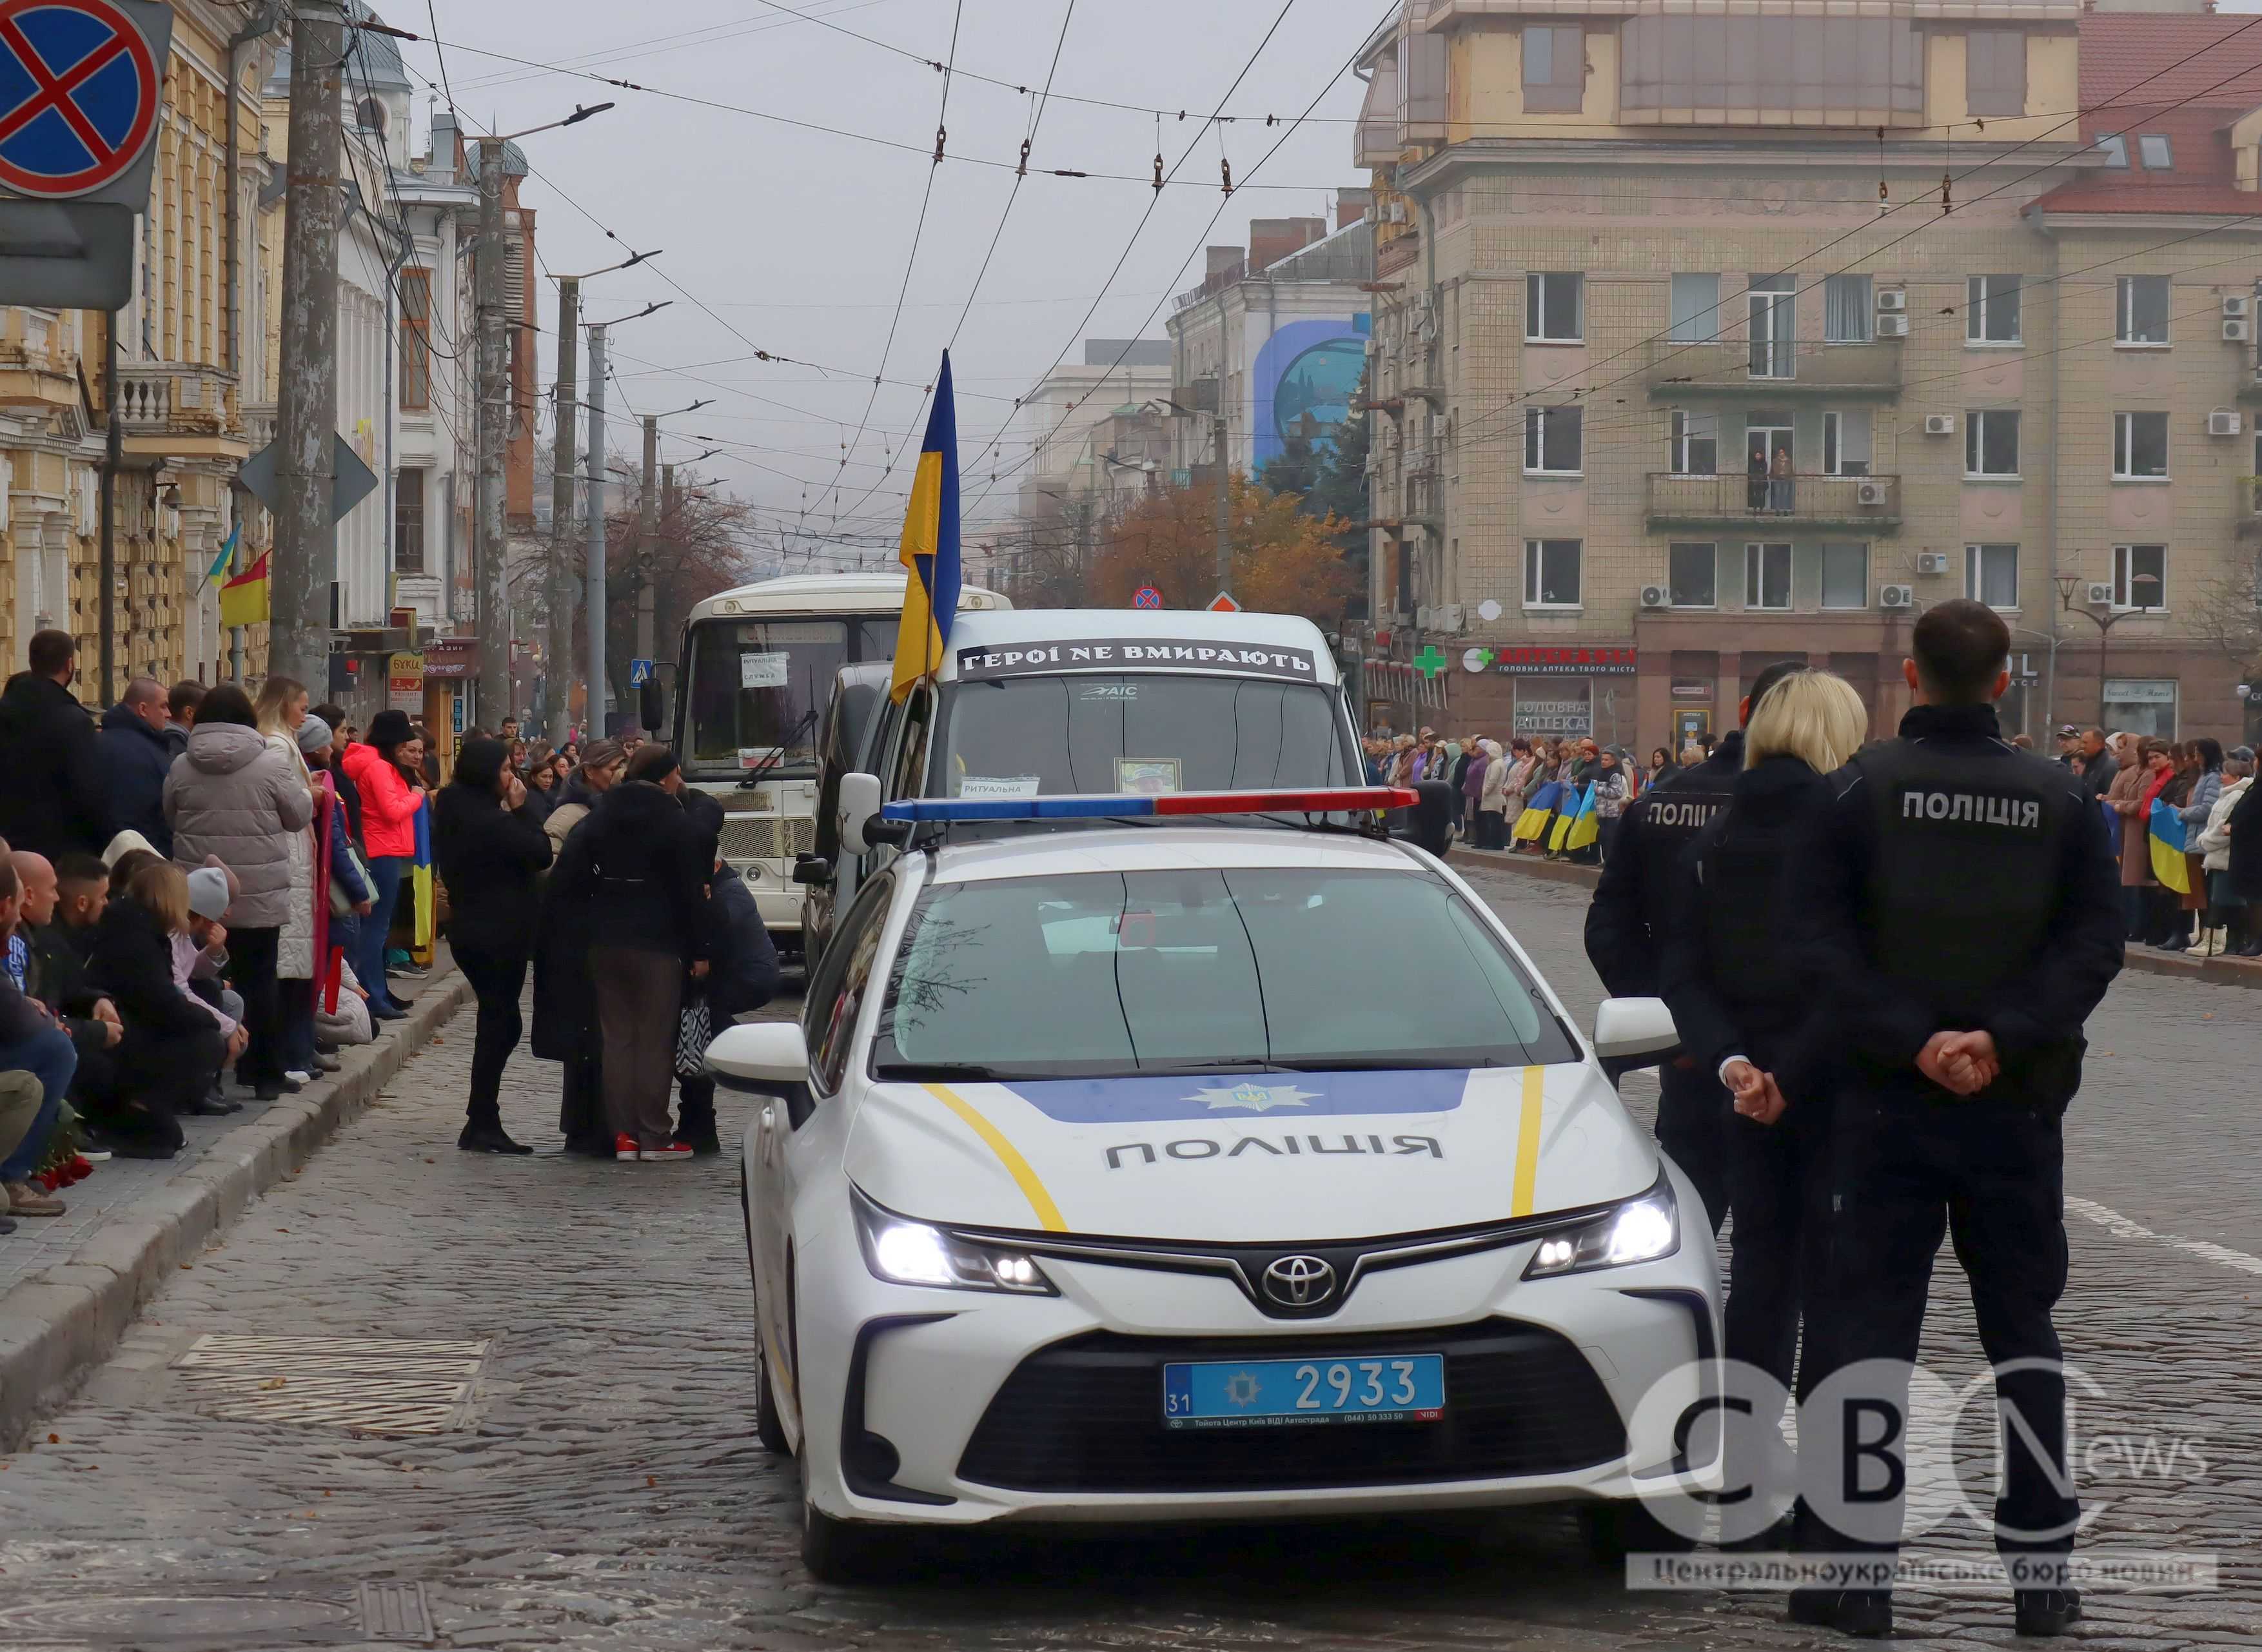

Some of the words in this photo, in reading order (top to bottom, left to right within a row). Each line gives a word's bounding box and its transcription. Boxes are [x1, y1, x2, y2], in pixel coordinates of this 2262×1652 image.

[963, 646, 1061, 671] ГЕРОЇ
[1122, 646, 1311, 671] ВМИРАЮТЬ
[1498, 649, 1590, 664] АПТЕКА
[1517, 717, 1588, 729] АПТЕКА
[1903, 792, 2039, 827] ПОЛІЦІЯ
[1105, 1135, 1444, 1169] ПОЛІЦІЯ
[1168, 1394, 1190, 1412] 31
[1295, 1361, 1415, 1409] 2933
